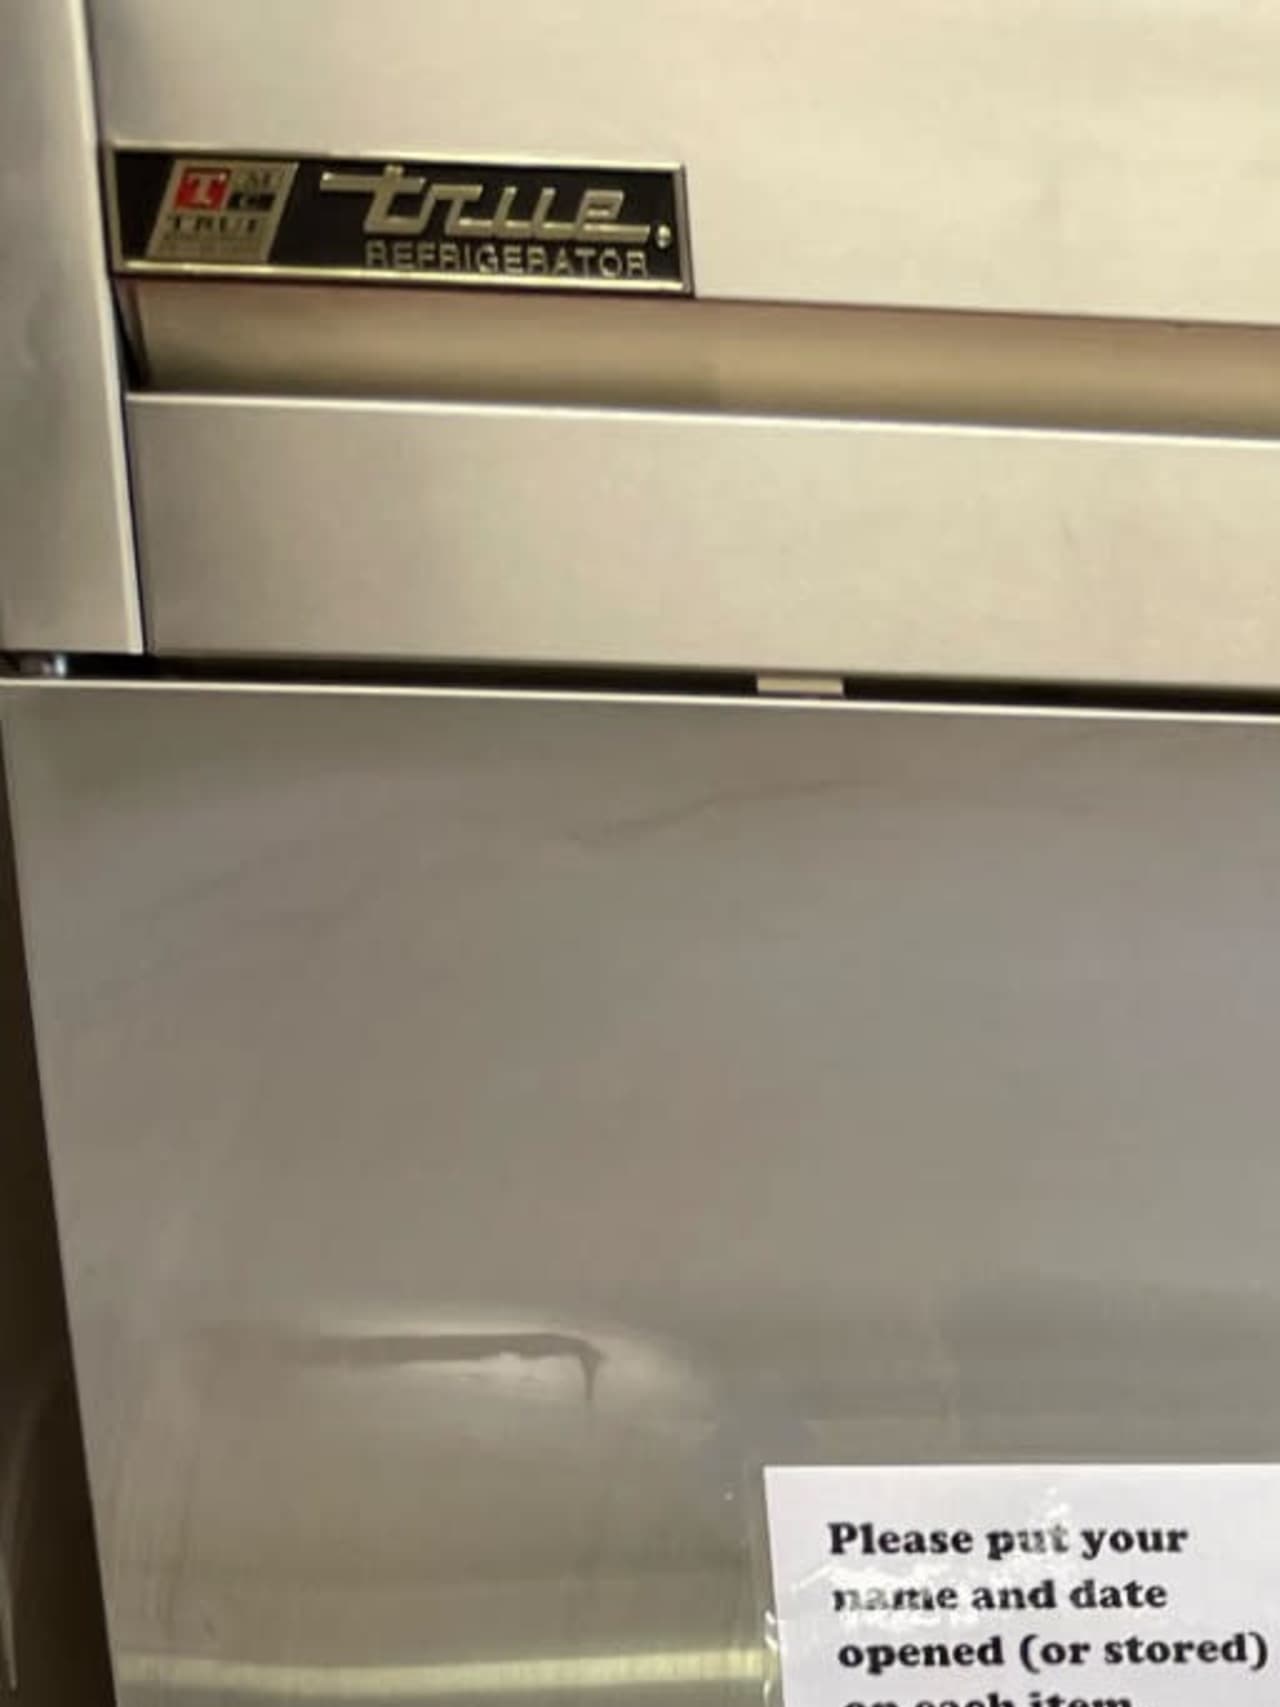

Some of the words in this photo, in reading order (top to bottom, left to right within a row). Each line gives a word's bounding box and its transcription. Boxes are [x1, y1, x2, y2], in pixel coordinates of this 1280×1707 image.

[364, 239, 649, 279] REFRIGERATOR
[828, 1521, 974, 1556] Please
[985, 1524, 1070, 1562] put
[1079, 1528, 1189, 1561] your
[970, 1578, 1058, 1611] and
[1068, 1578, 1168, 1610] date
[837, 1634, 1005, 1677] opened
[1019, 1633, 1092, 1675] (or
[1103, 1631, 1268, 1672] stored)
